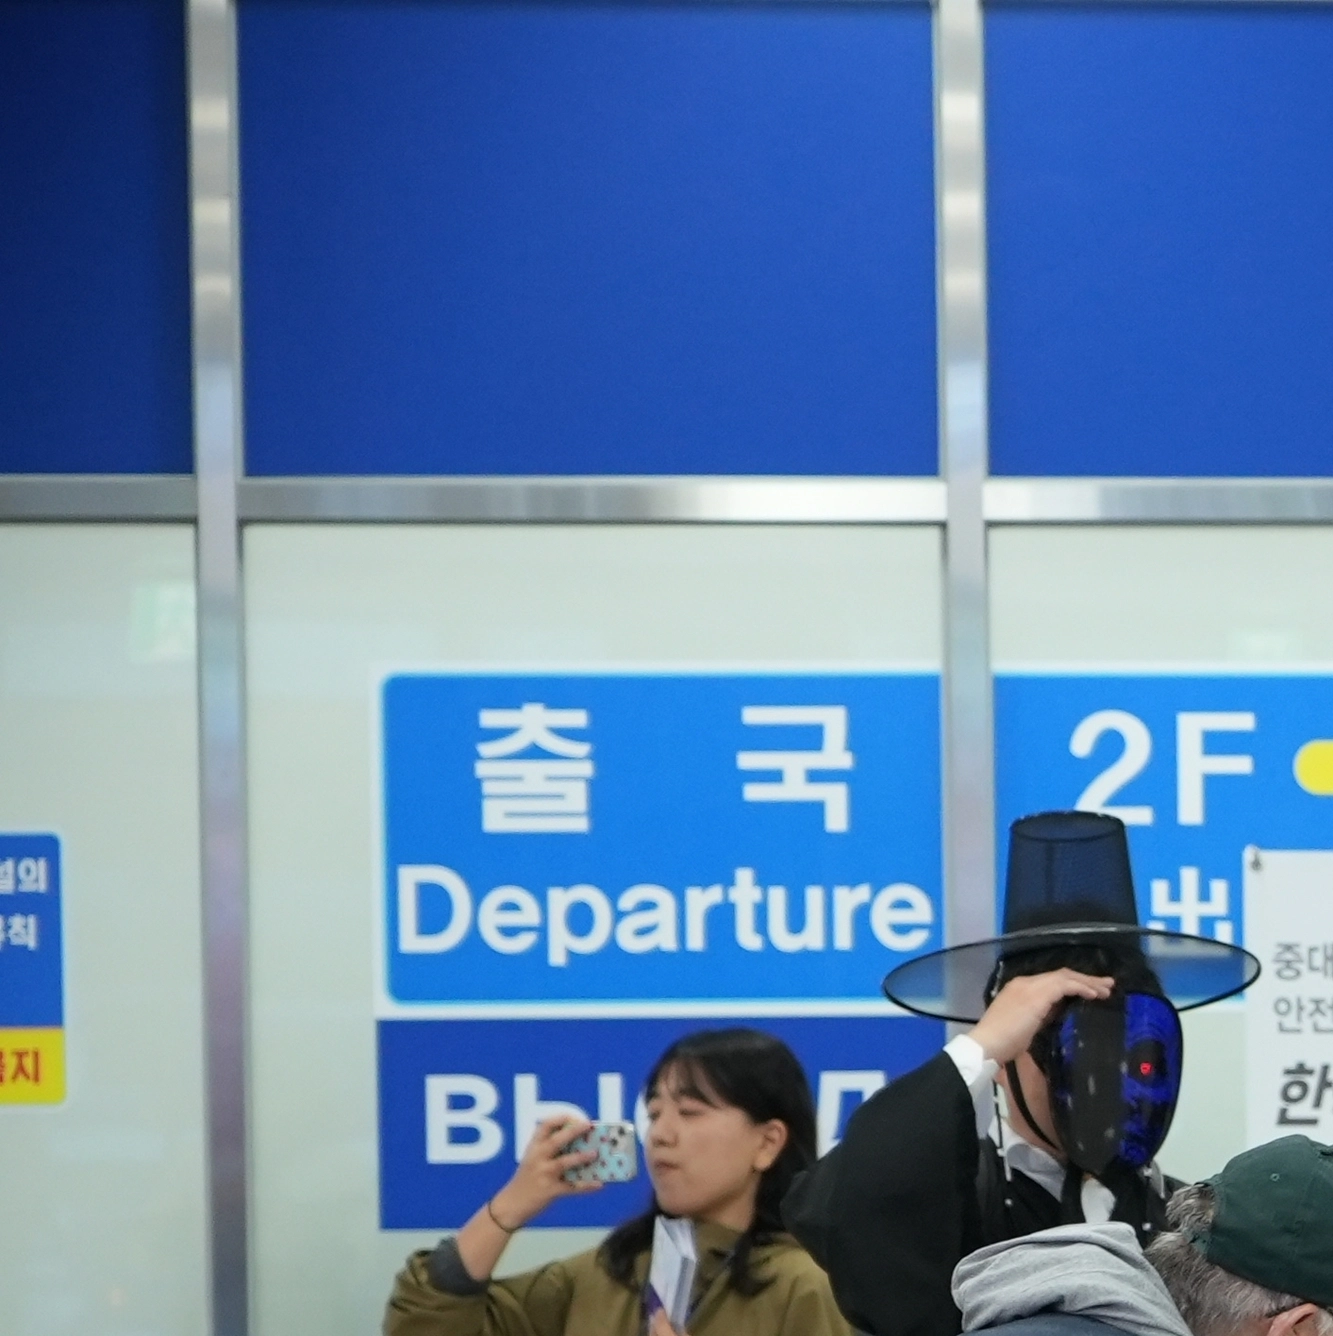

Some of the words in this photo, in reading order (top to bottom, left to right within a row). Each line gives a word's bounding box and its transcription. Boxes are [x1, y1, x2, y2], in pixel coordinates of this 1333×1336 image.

[1069, 709, 1256, 826] 2F
[0, 912, 38, 951] 칙
[396, 863, 935, 968] Departure
[0, 1048, 40, 1084] 지
